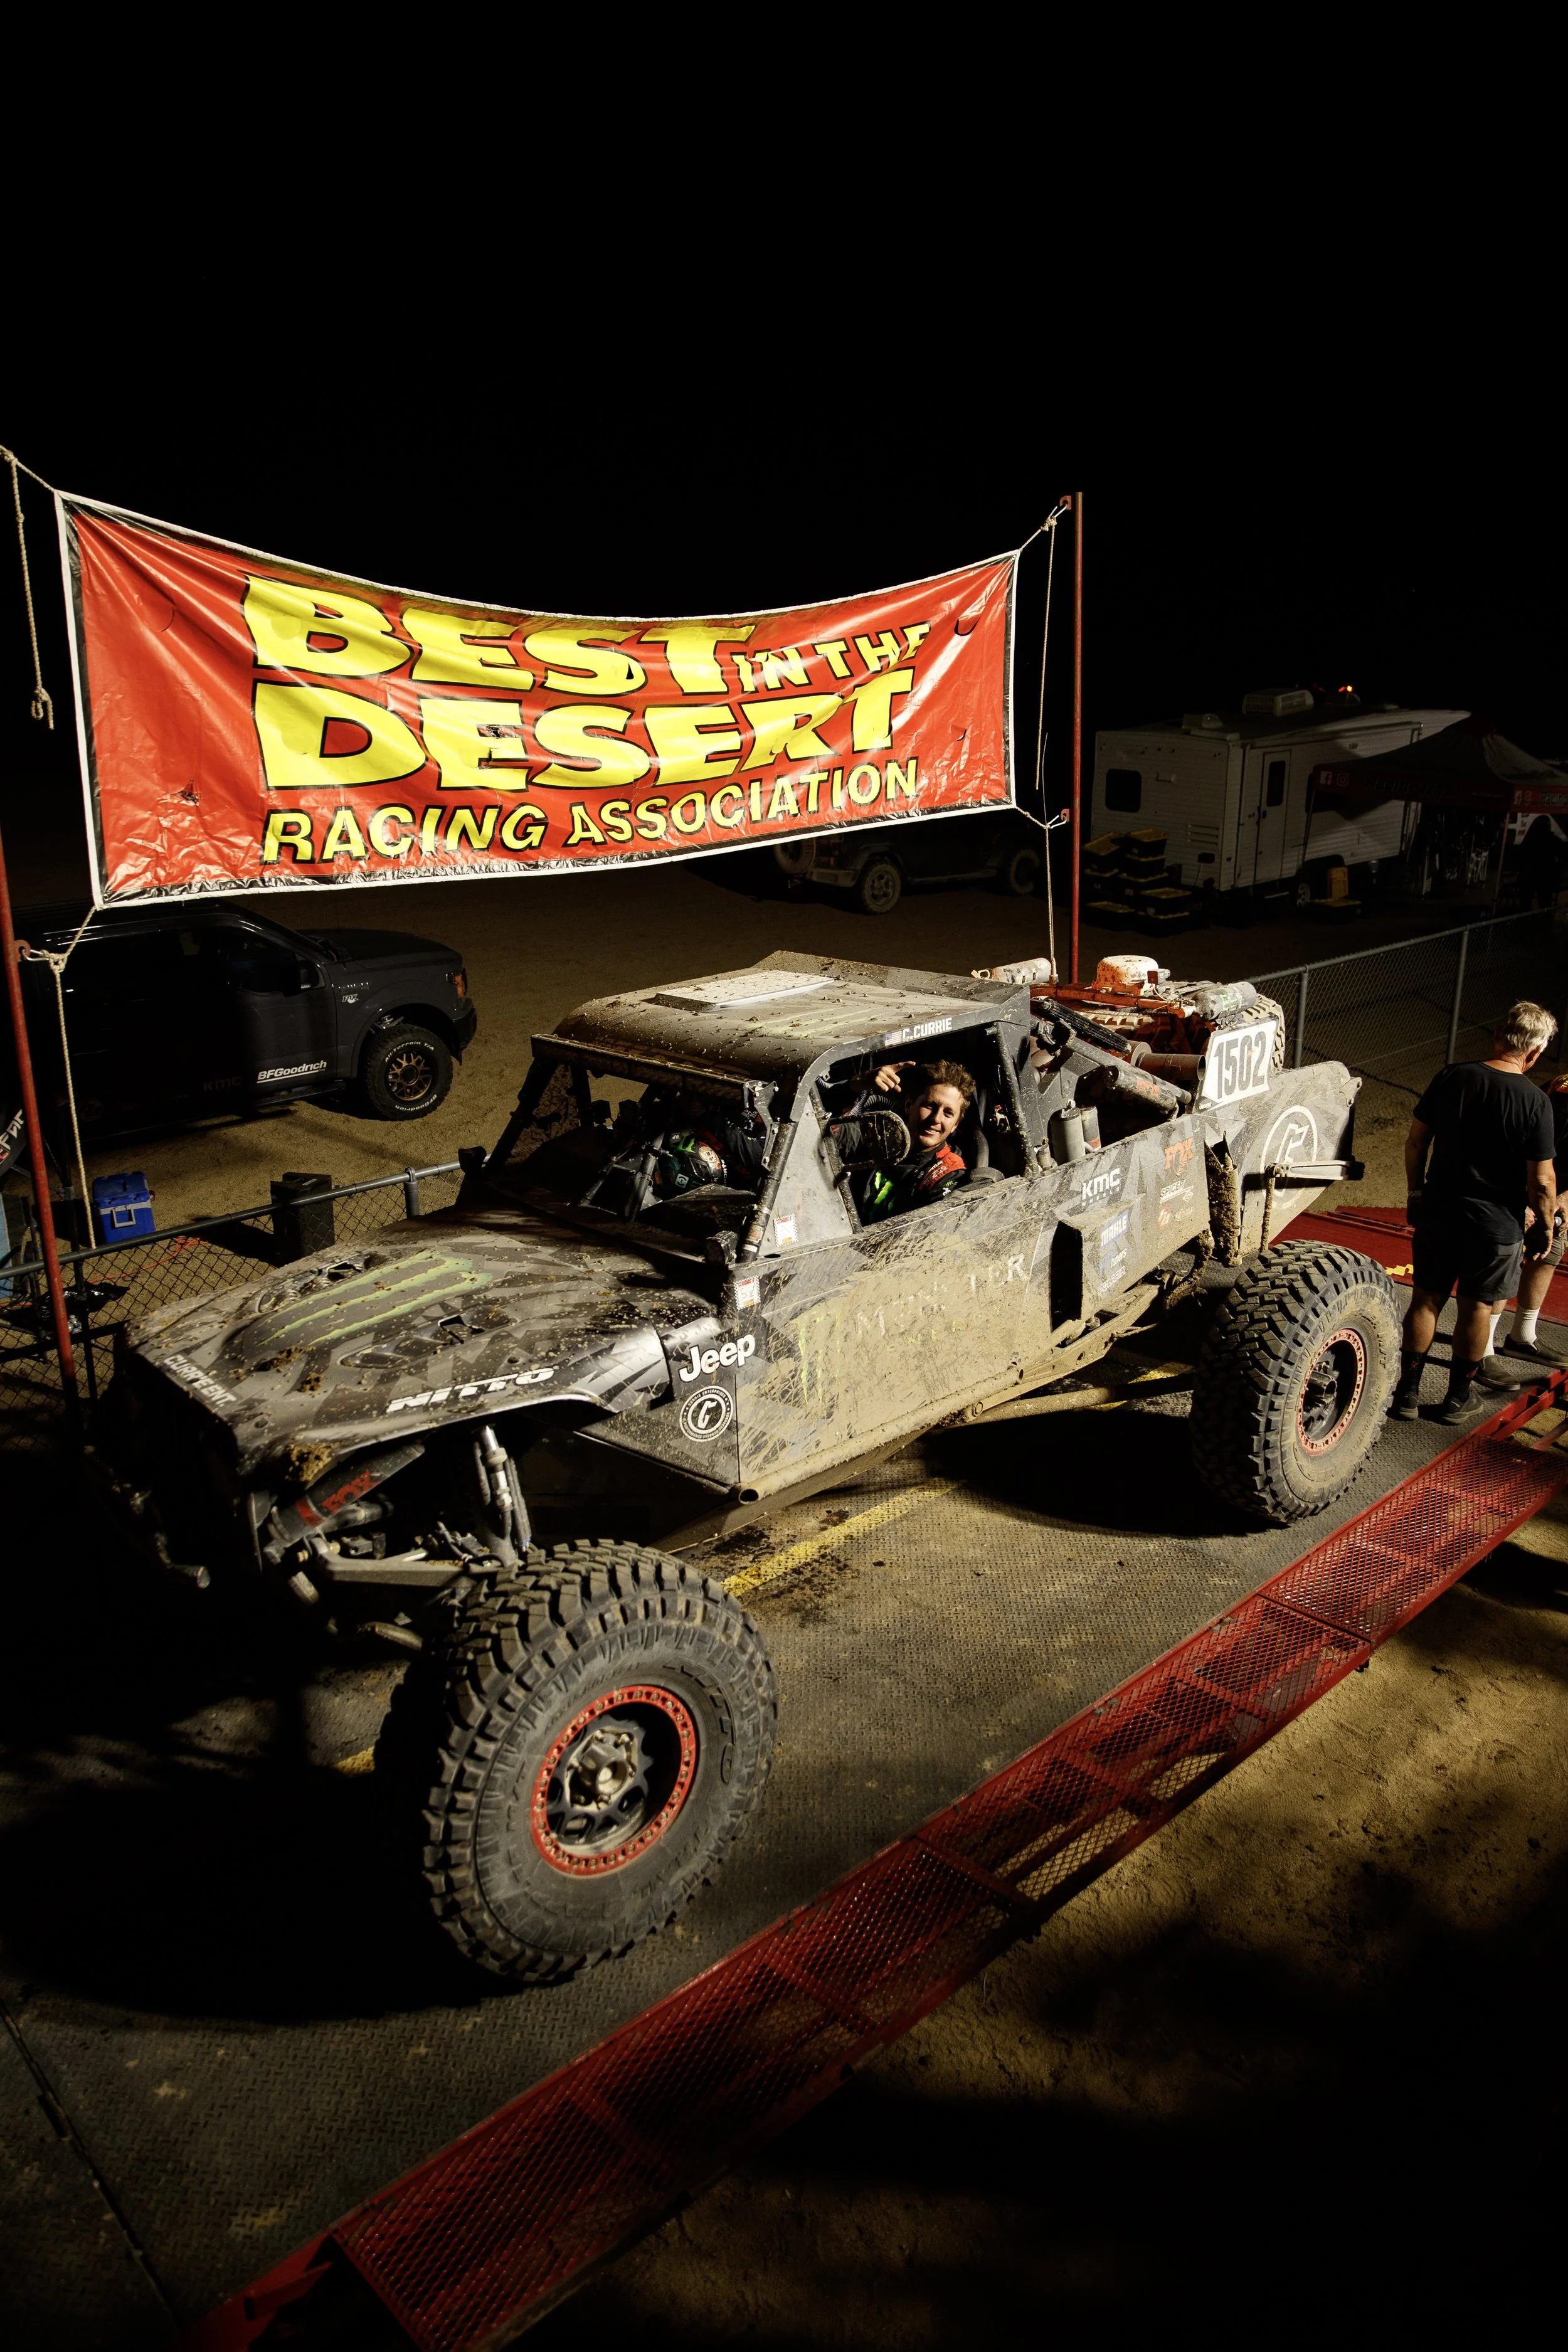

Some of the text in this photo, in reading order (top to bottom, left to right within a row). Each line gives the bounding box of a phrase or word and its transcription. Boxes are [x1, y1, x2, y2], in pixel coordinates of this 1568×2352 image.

[241, 572, 931, 695] BEST IN THE
[251, 667, 913, 792] DESERT
[258, 757, 918, 866] RACING ASSOCIATION
[257, 1059, 327, 1081] BFGoodrich
[1214, 1030, 1267, 1099] 1502
[1164, 1136, 1194, 1170] FOX
[1082, 1167, 1120, 1200] KMC
[1160, 1179, 1186, 1199] SPICER
[1101, 1214, 1128, 1247] MAHLE
[679, 1333, 756, 1383] Jeep
[386, 1367, 555, 1412] NITTO
